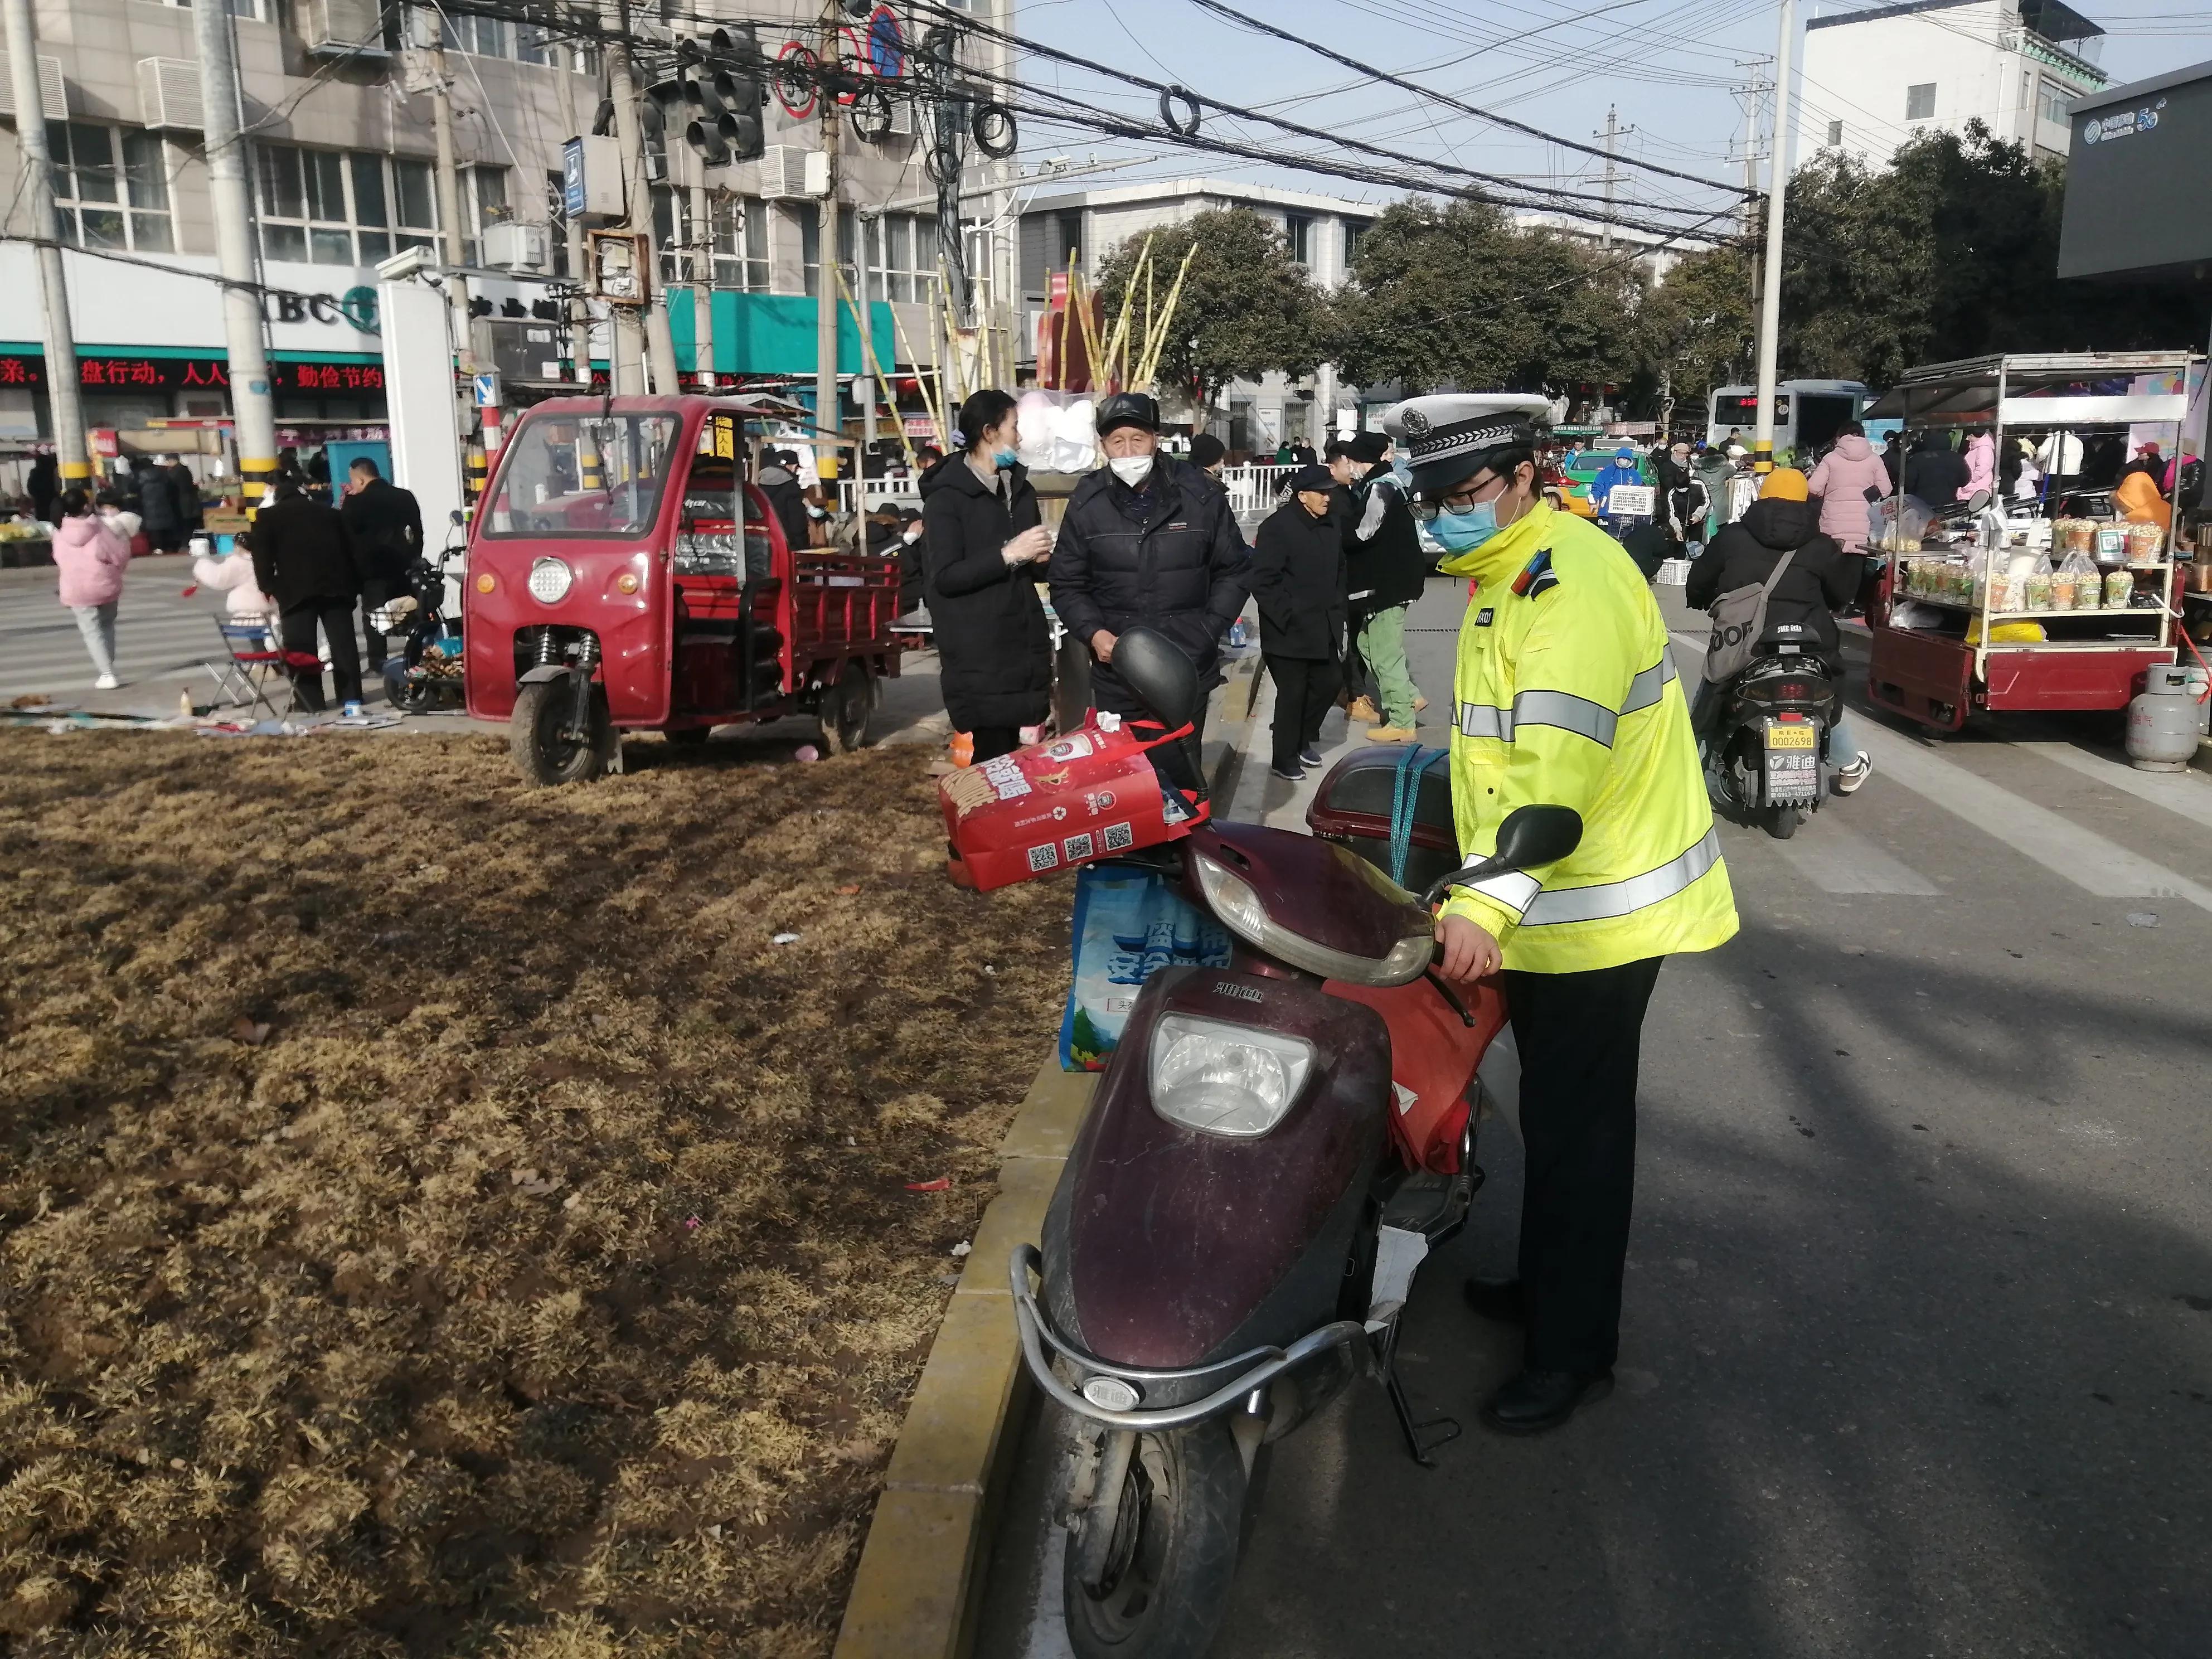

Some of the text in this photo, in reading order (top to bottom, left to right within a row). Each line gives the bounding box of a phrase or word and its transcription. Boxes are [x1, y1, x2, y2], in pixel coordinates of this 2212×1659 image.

[2102, 111, 2135, 130] 中国移动
[1777, 624, 1803, 633] 雅迪
[1772, 736, 1812, 746] 0002698
[1786, 755, 1816, 769] 雅迪
